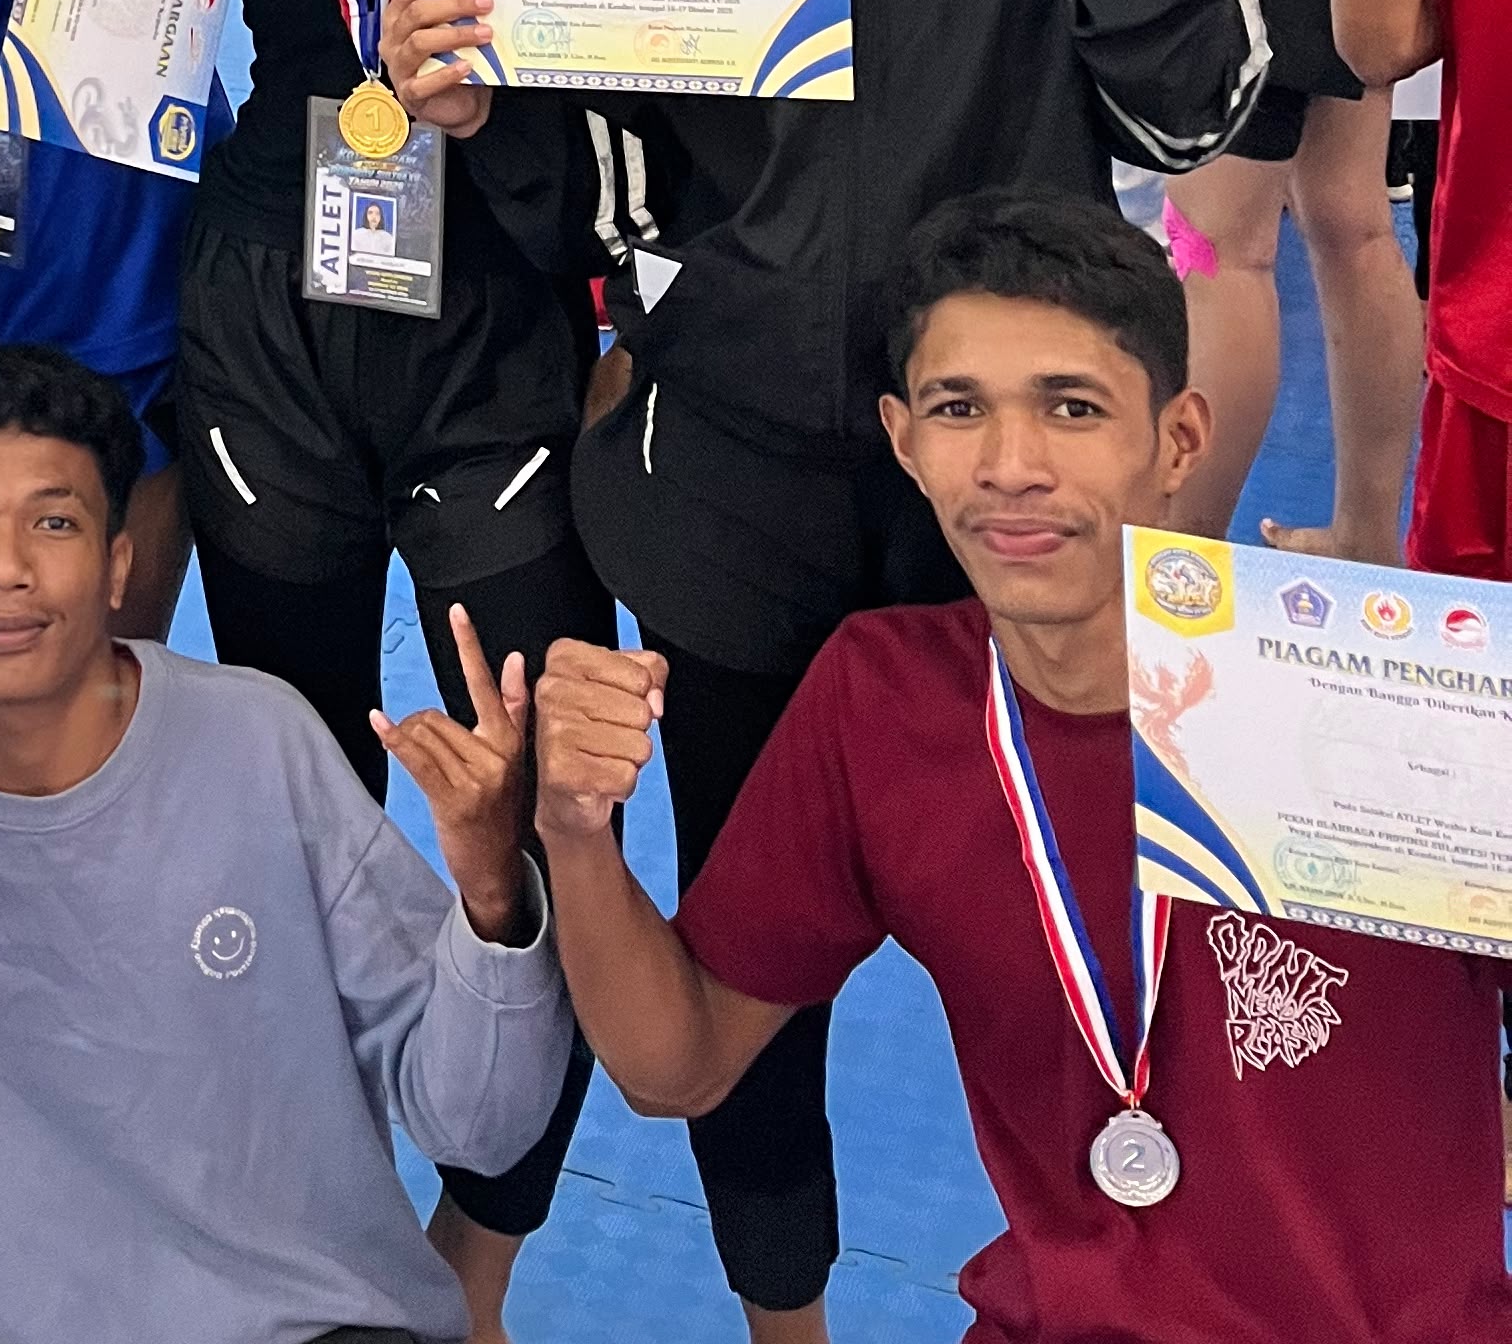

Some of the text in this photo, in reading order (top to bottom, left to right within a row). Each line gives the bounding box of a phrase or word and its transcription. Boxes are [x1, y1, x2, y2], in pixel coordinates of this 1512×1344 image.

[365, 104, 381, 131] 1
[320, 185, 342, 275] ATLET
[1257, 636, 1374, 677] PIAGAM
[1308, 677, 1363, 695] Dengan
[1366, 687, 1420, 707] Bangga
[1423, 697, 1496, 719] Diberikan
[1122, 1138, 1146, 1173] 2
